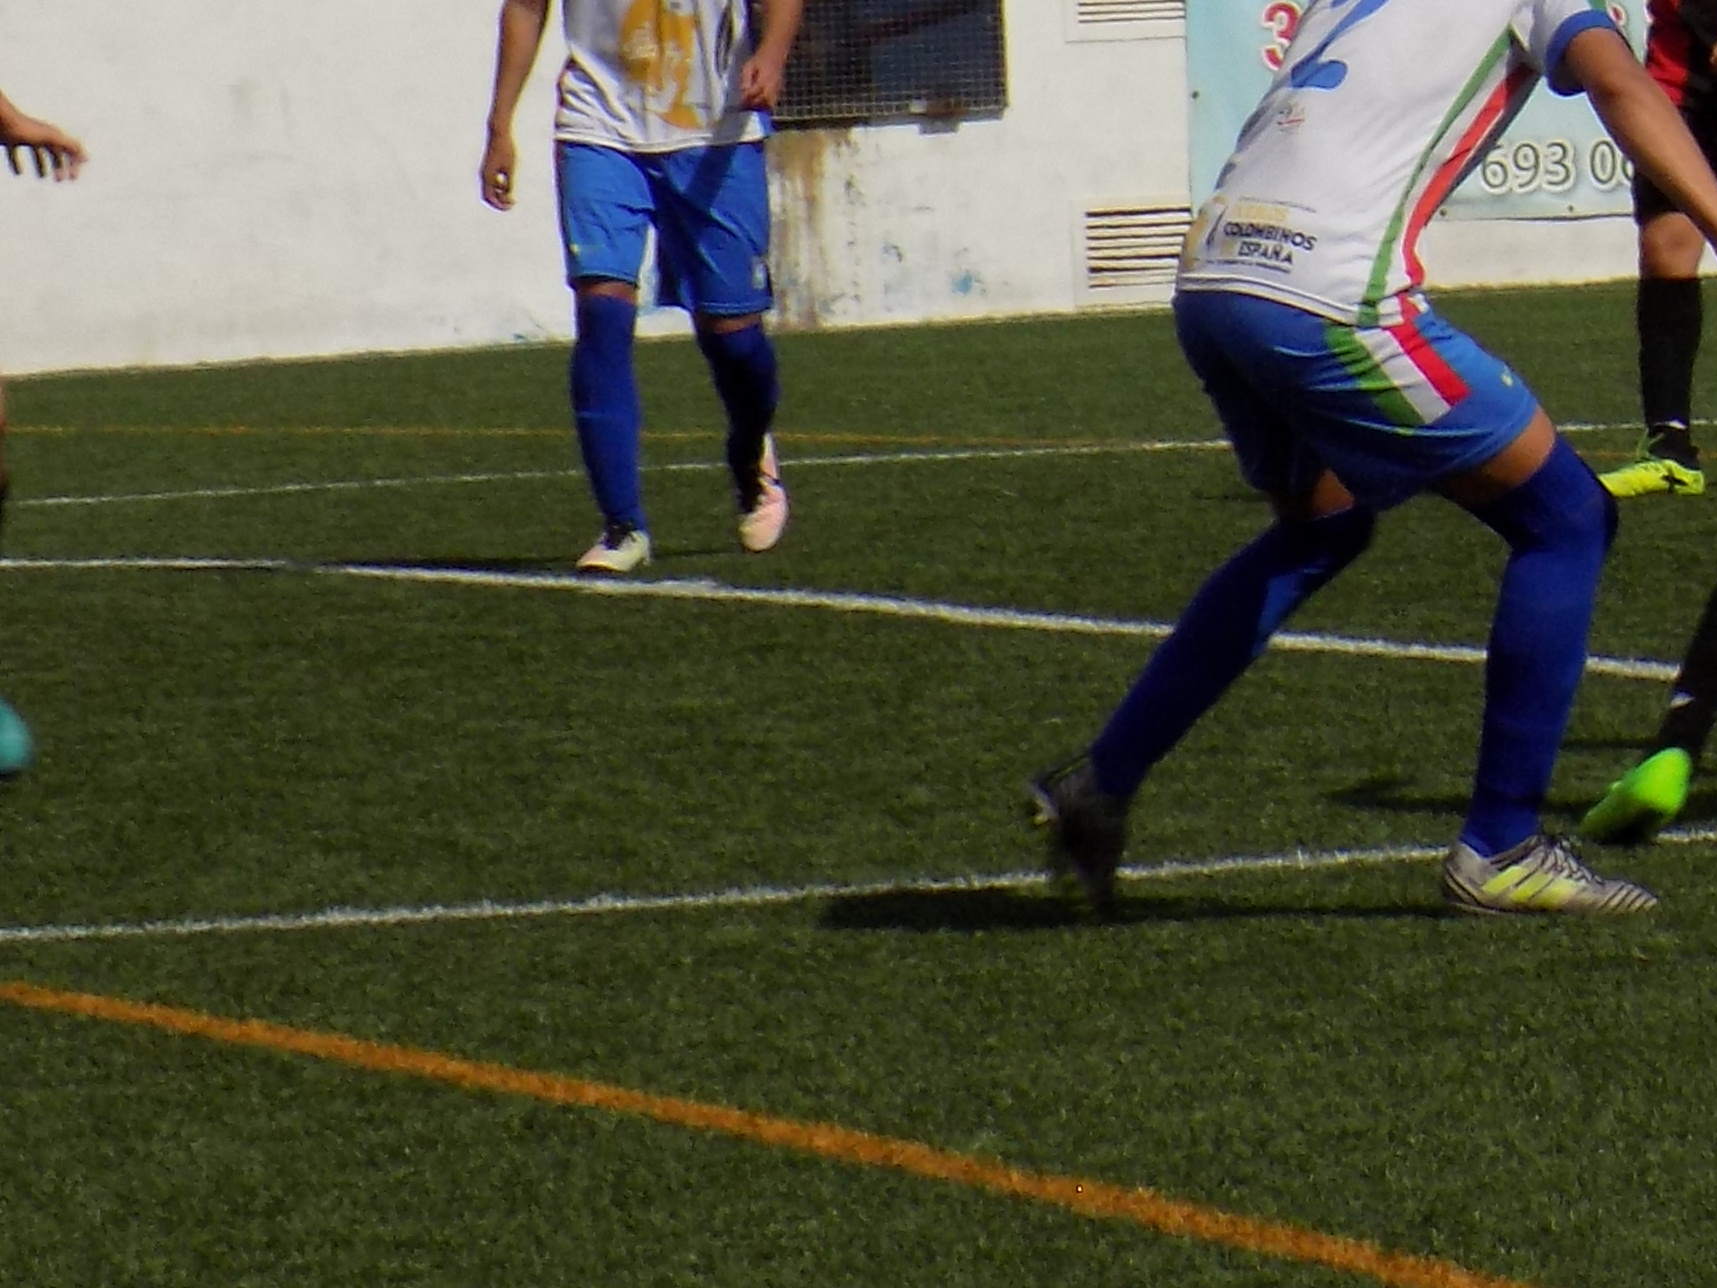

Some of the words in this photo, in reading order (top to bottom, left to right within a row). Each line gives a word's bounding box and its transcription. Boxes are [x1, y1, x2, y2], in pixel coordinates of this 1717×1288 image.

[1481, 138, 1573, 192] 693
[1223, 221, 1318, 251] COLOMBINOS
[1238, 241, 1294, 265] ESPAÑA
